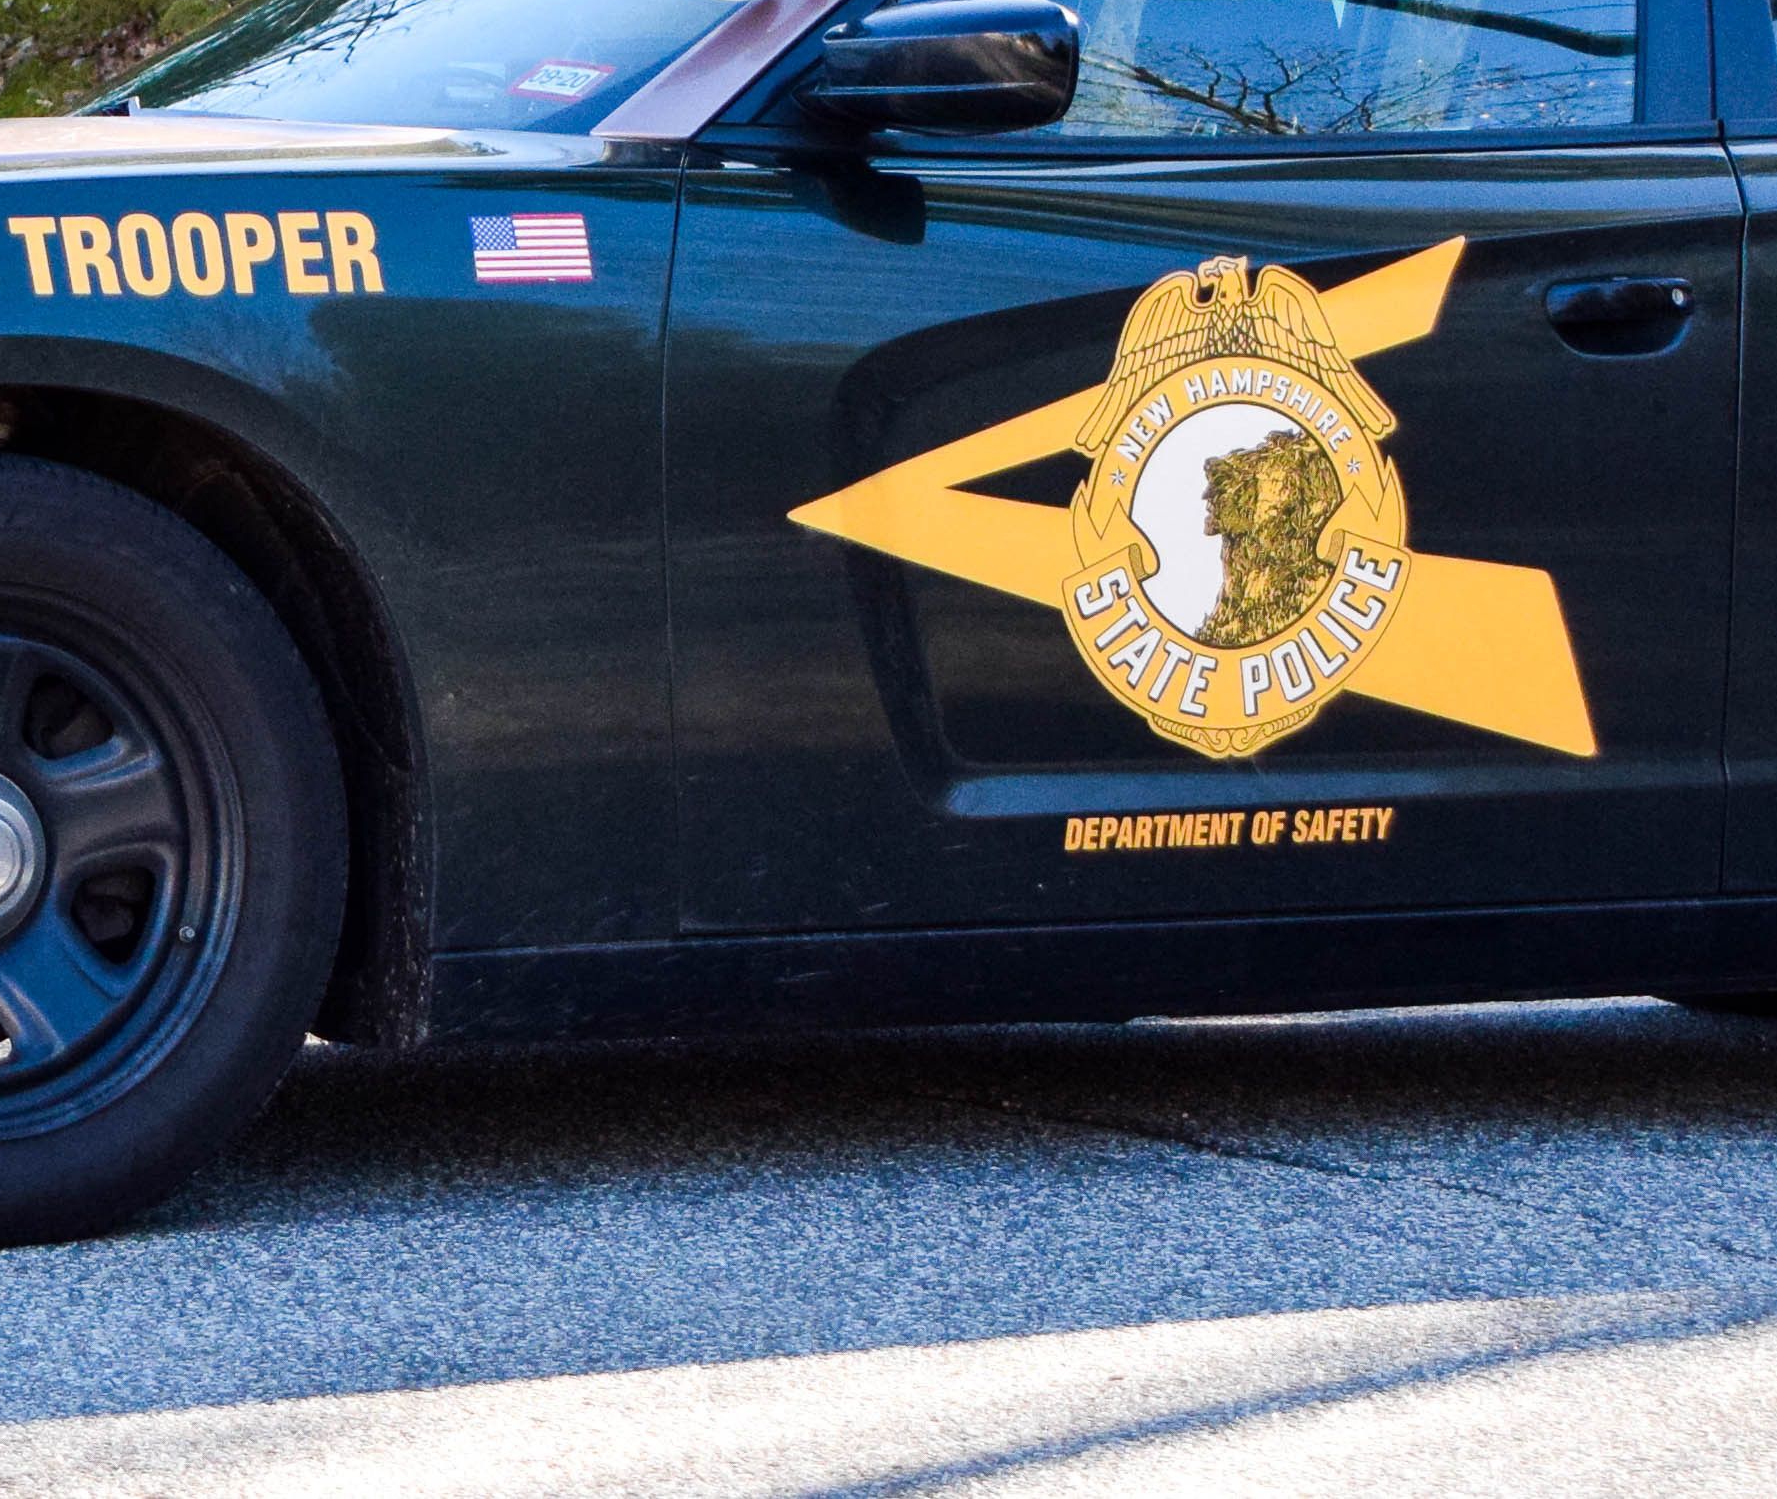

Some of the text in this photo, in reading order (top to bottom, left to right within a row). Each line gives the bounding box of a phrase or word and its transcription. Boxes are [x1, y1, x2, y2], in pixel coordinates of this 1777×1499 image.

[8, 211, 385, 298] TROOPER
[1116, 367, 1354, 464] NEW HAMPSHIRE
[1075, 547, 1402, 718] STATE POLICE
[1063, 807, 1393, 851] DEPARTMENT OF SAFETY
